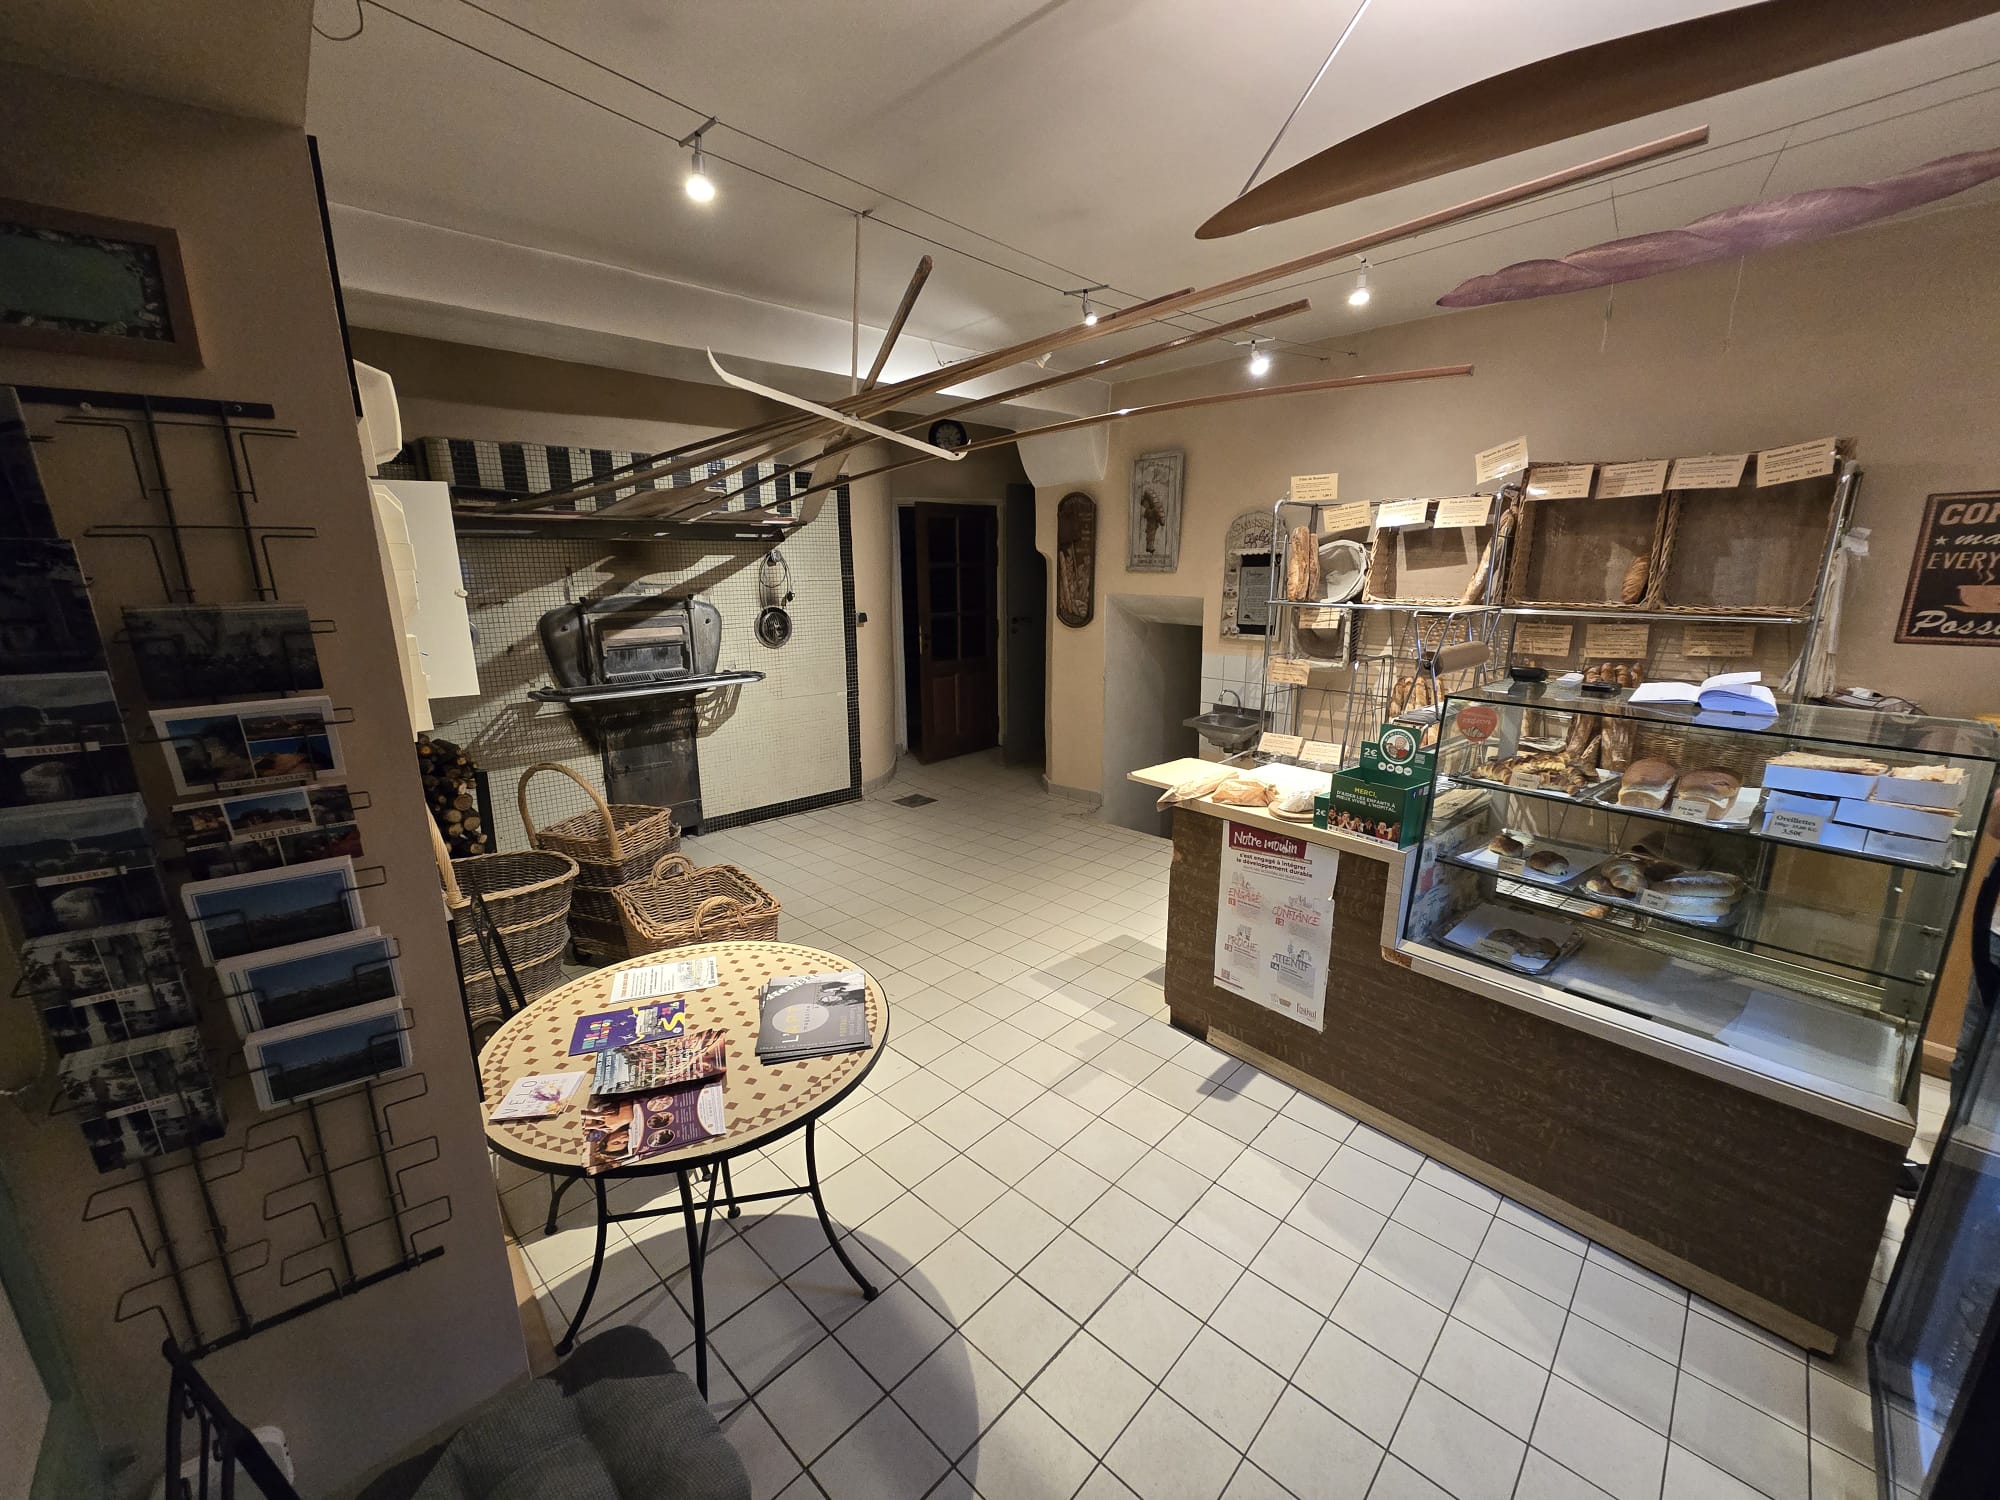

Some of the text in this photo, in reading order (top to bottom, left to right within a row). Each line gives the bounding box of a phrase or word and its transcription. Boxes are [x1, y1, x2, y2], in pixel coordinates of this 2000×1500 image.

[1364, 747, 1378, 757] 2€
[1366, 797, 1390, 807] ENFANTS
[1315, 808, 1327, 817] 2€
[1776, 814, 1816, 827] Oreillettes
[249, 826, 302, 841] VILLARS
[1234, 830, 1298, 854] Notre moulin
[1243, 859, 1290, 873] développement
[1289, 867, 1313, 879] durable
[1253, 855, 1276, 865] engagé
[1281, 860, 1307, 871] intégrer
[1272, 905, 1320, 926] CONFIANCE
[1272, 952, 1313, 972] ATTENTIF
